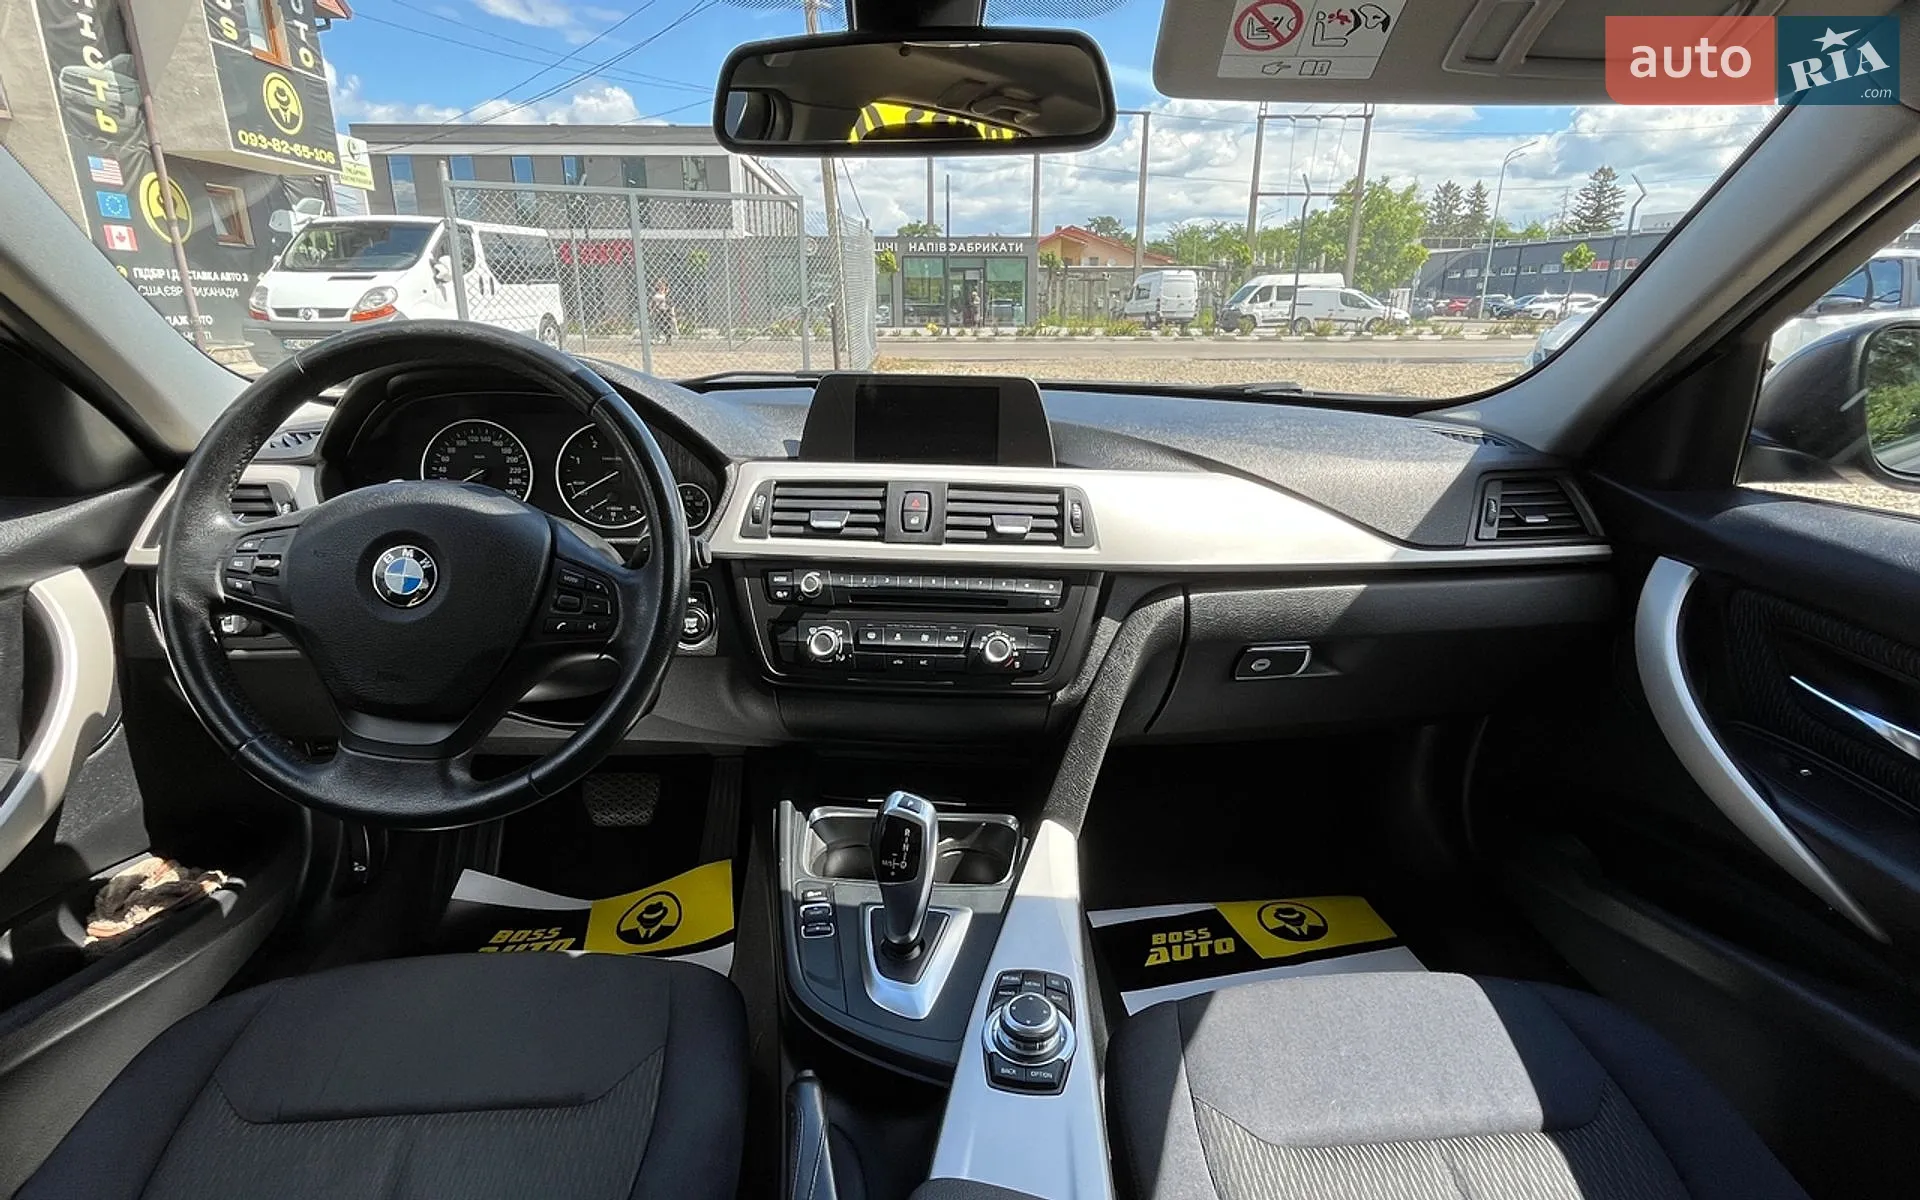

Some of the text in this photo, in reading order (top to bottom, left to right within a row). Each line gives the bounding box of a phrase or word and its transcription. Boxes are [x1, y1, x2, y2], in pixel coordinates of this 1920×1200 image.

[908, 242, 1024, 253] НАПІВФАБРИКАТИ
[383, 548, 433, 569] BMW
[489, 927, 563, 944] BOSS
[1152, 927, 1211, 945] BOSS
[1144, 937, 1236, 967] AUTO
[1000, 1067, 1017, 1076] BACK
[1029, 1070, 1053, 1079] OPTION
